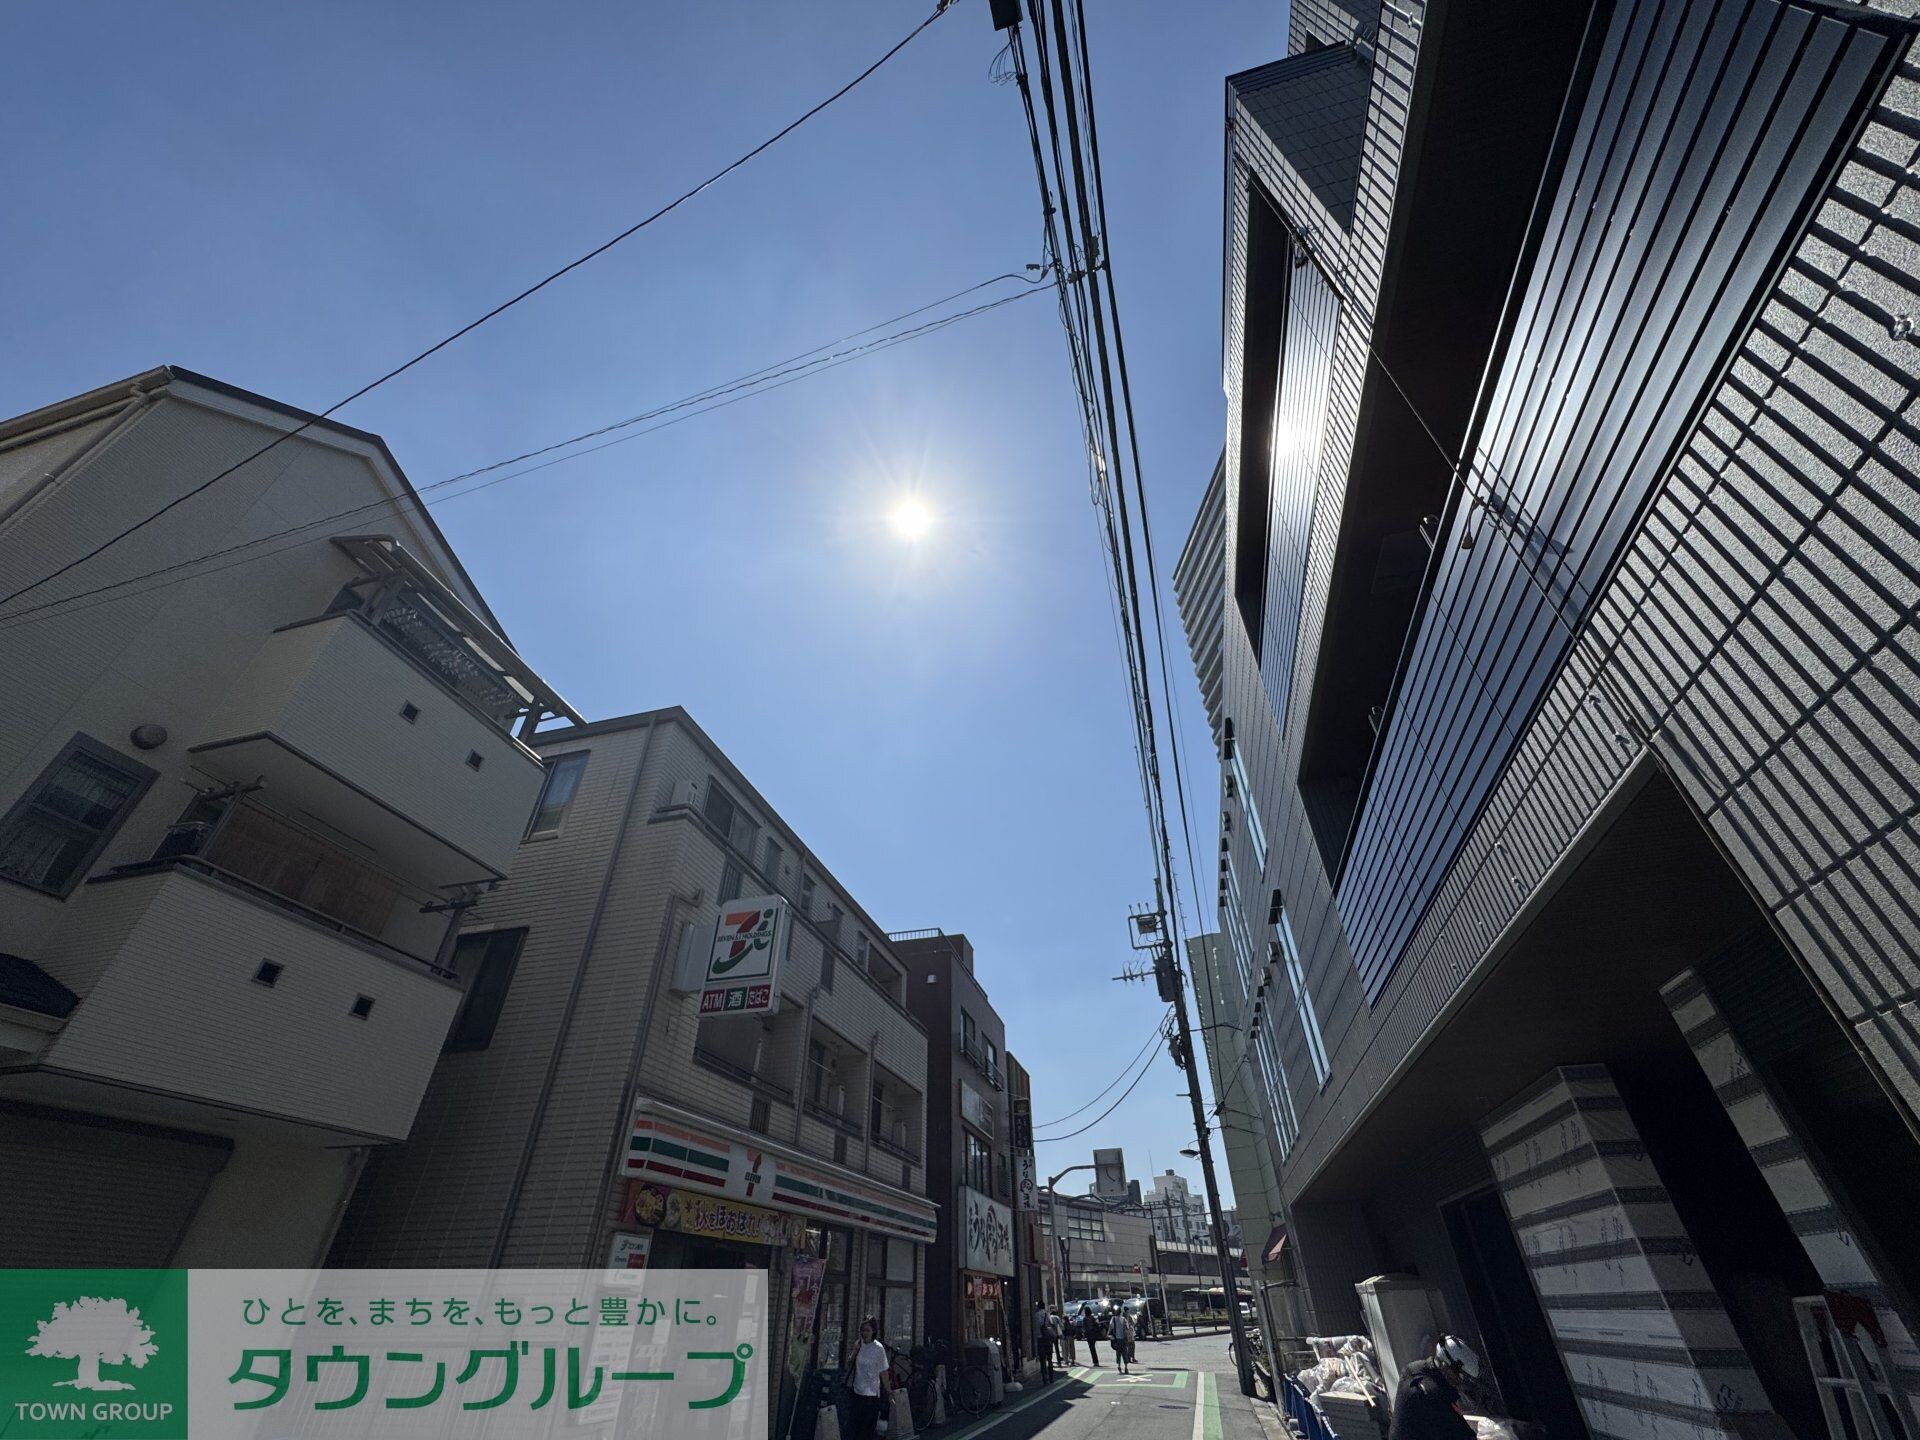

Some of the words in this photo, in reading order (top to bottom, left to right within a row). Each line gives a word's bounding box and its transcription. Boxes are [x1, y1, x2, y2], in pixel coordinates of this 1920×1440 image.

[703, 992, 723, 1010] ATM
[728, 990, 744, 1007] 酒
[747, 988, 770, 1006] たばこ
